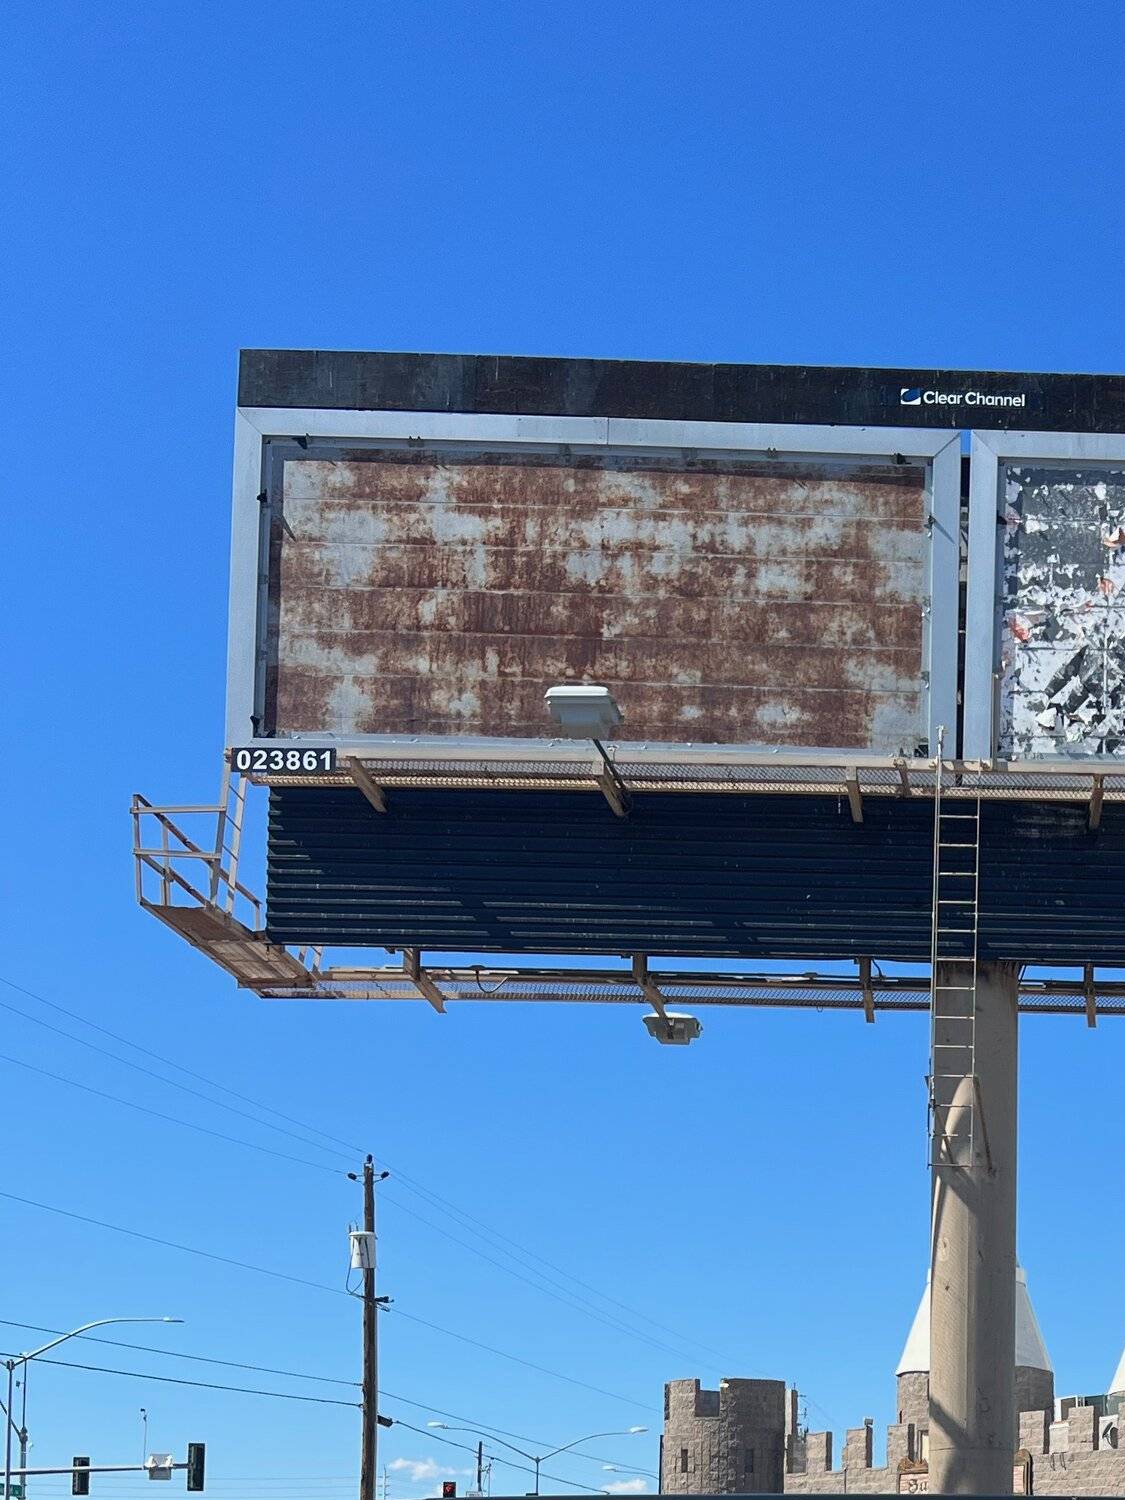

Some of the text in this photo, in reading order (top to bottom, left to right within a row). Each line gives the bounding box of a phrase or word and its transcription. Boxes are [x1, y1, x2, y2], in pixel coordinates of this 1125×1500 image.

[923, 391, 1026, 407] Clear Channel
[236, 749, 331, 771] 023861
